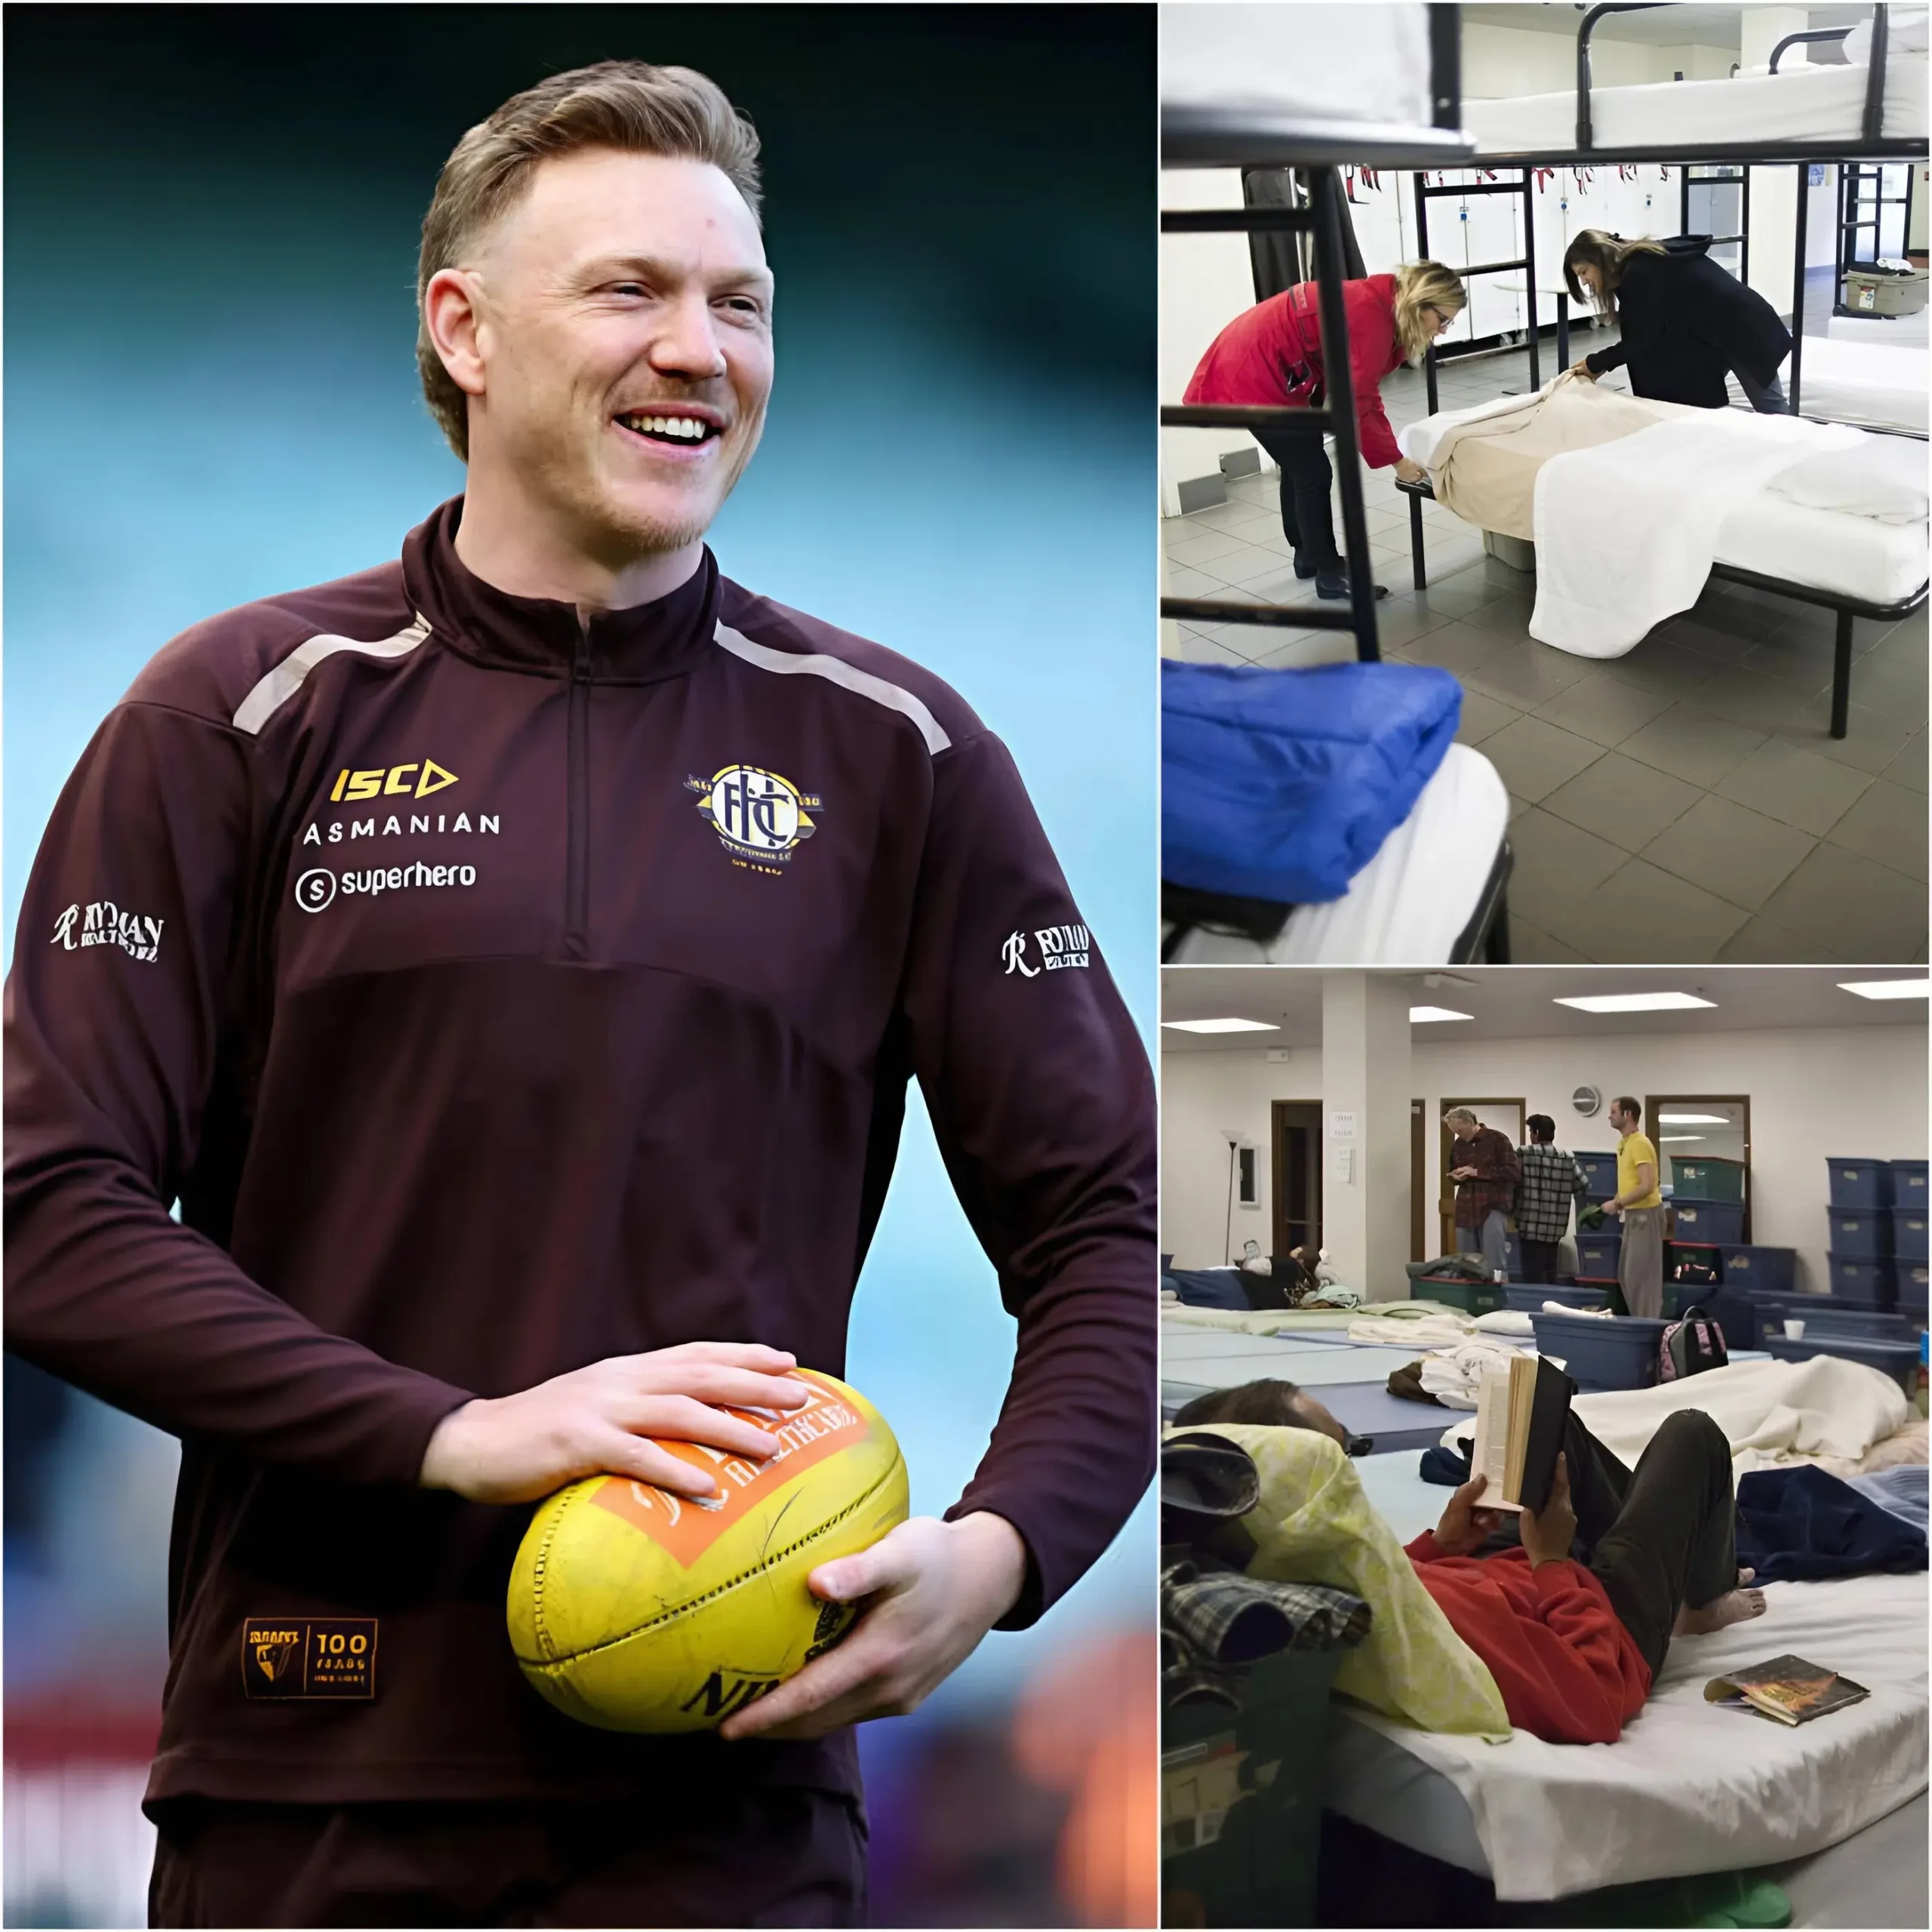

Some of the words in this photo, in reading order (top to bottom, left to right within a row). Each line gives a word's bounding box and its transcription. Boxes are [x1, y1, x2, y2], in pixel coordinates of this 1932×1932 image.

[303, 811, 500, 845] ASMANIAN
[341, 860, 477, 897] superhero
[317, 1634, 368, 1654] 100
